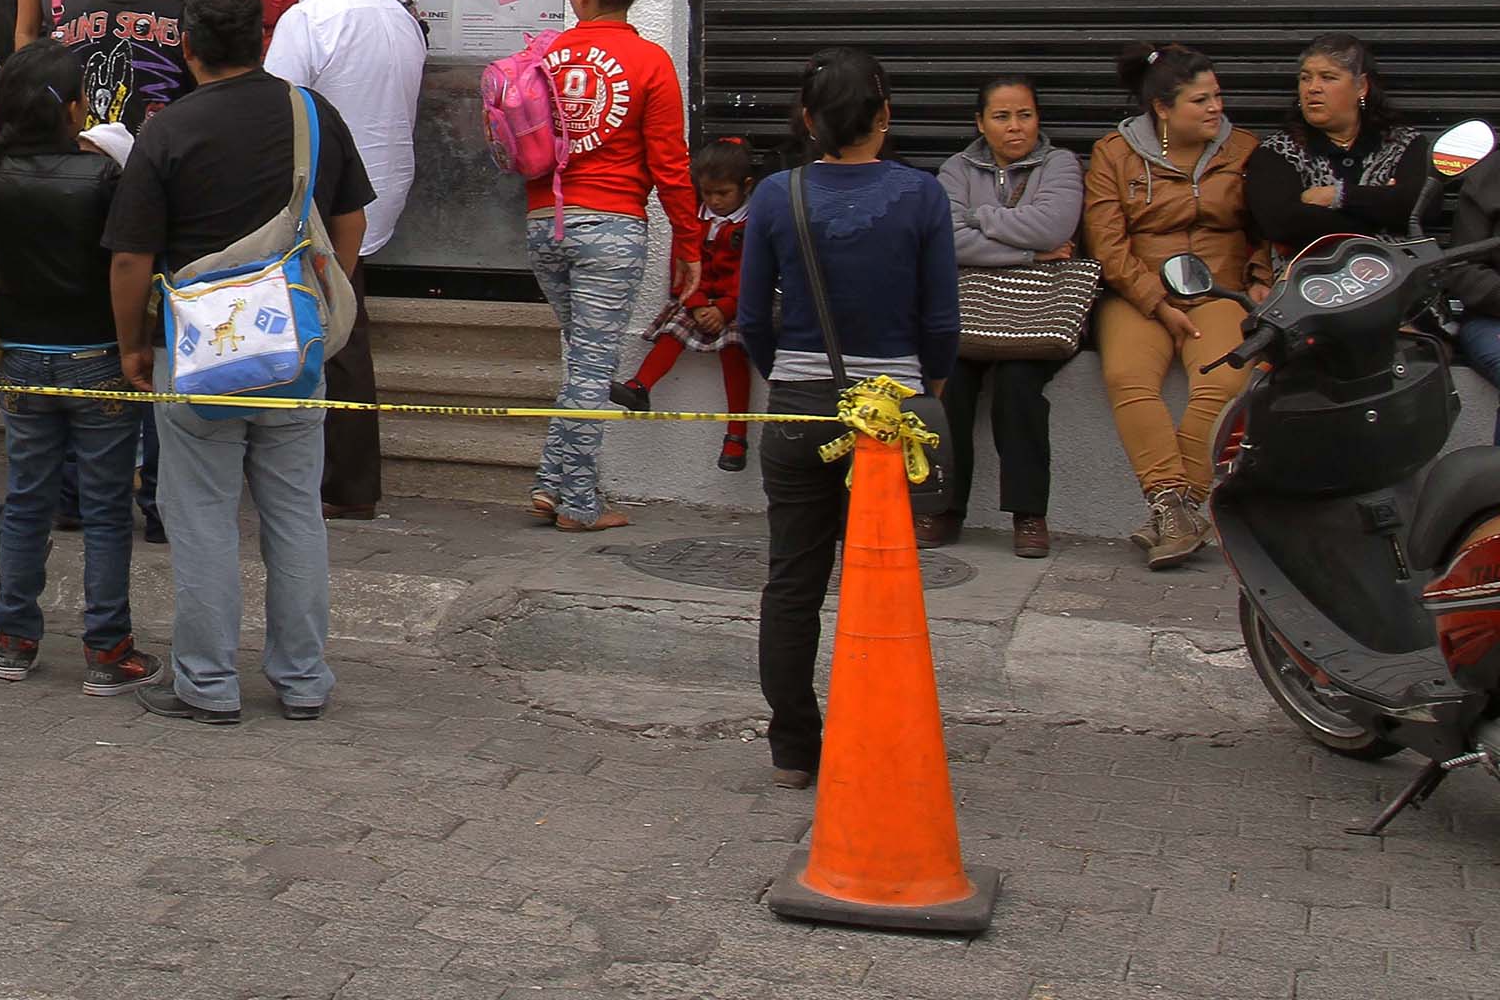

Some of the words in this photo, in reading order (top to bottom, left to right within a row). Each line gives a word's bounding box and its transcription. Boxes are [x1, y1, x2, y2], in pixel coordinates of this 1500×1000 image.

[428, 11, 449, 19] INE
[586, 46, 624, 78] PLAY
[605, 80, 630, 128] HARD
[258, 315, 267, 327] 2
